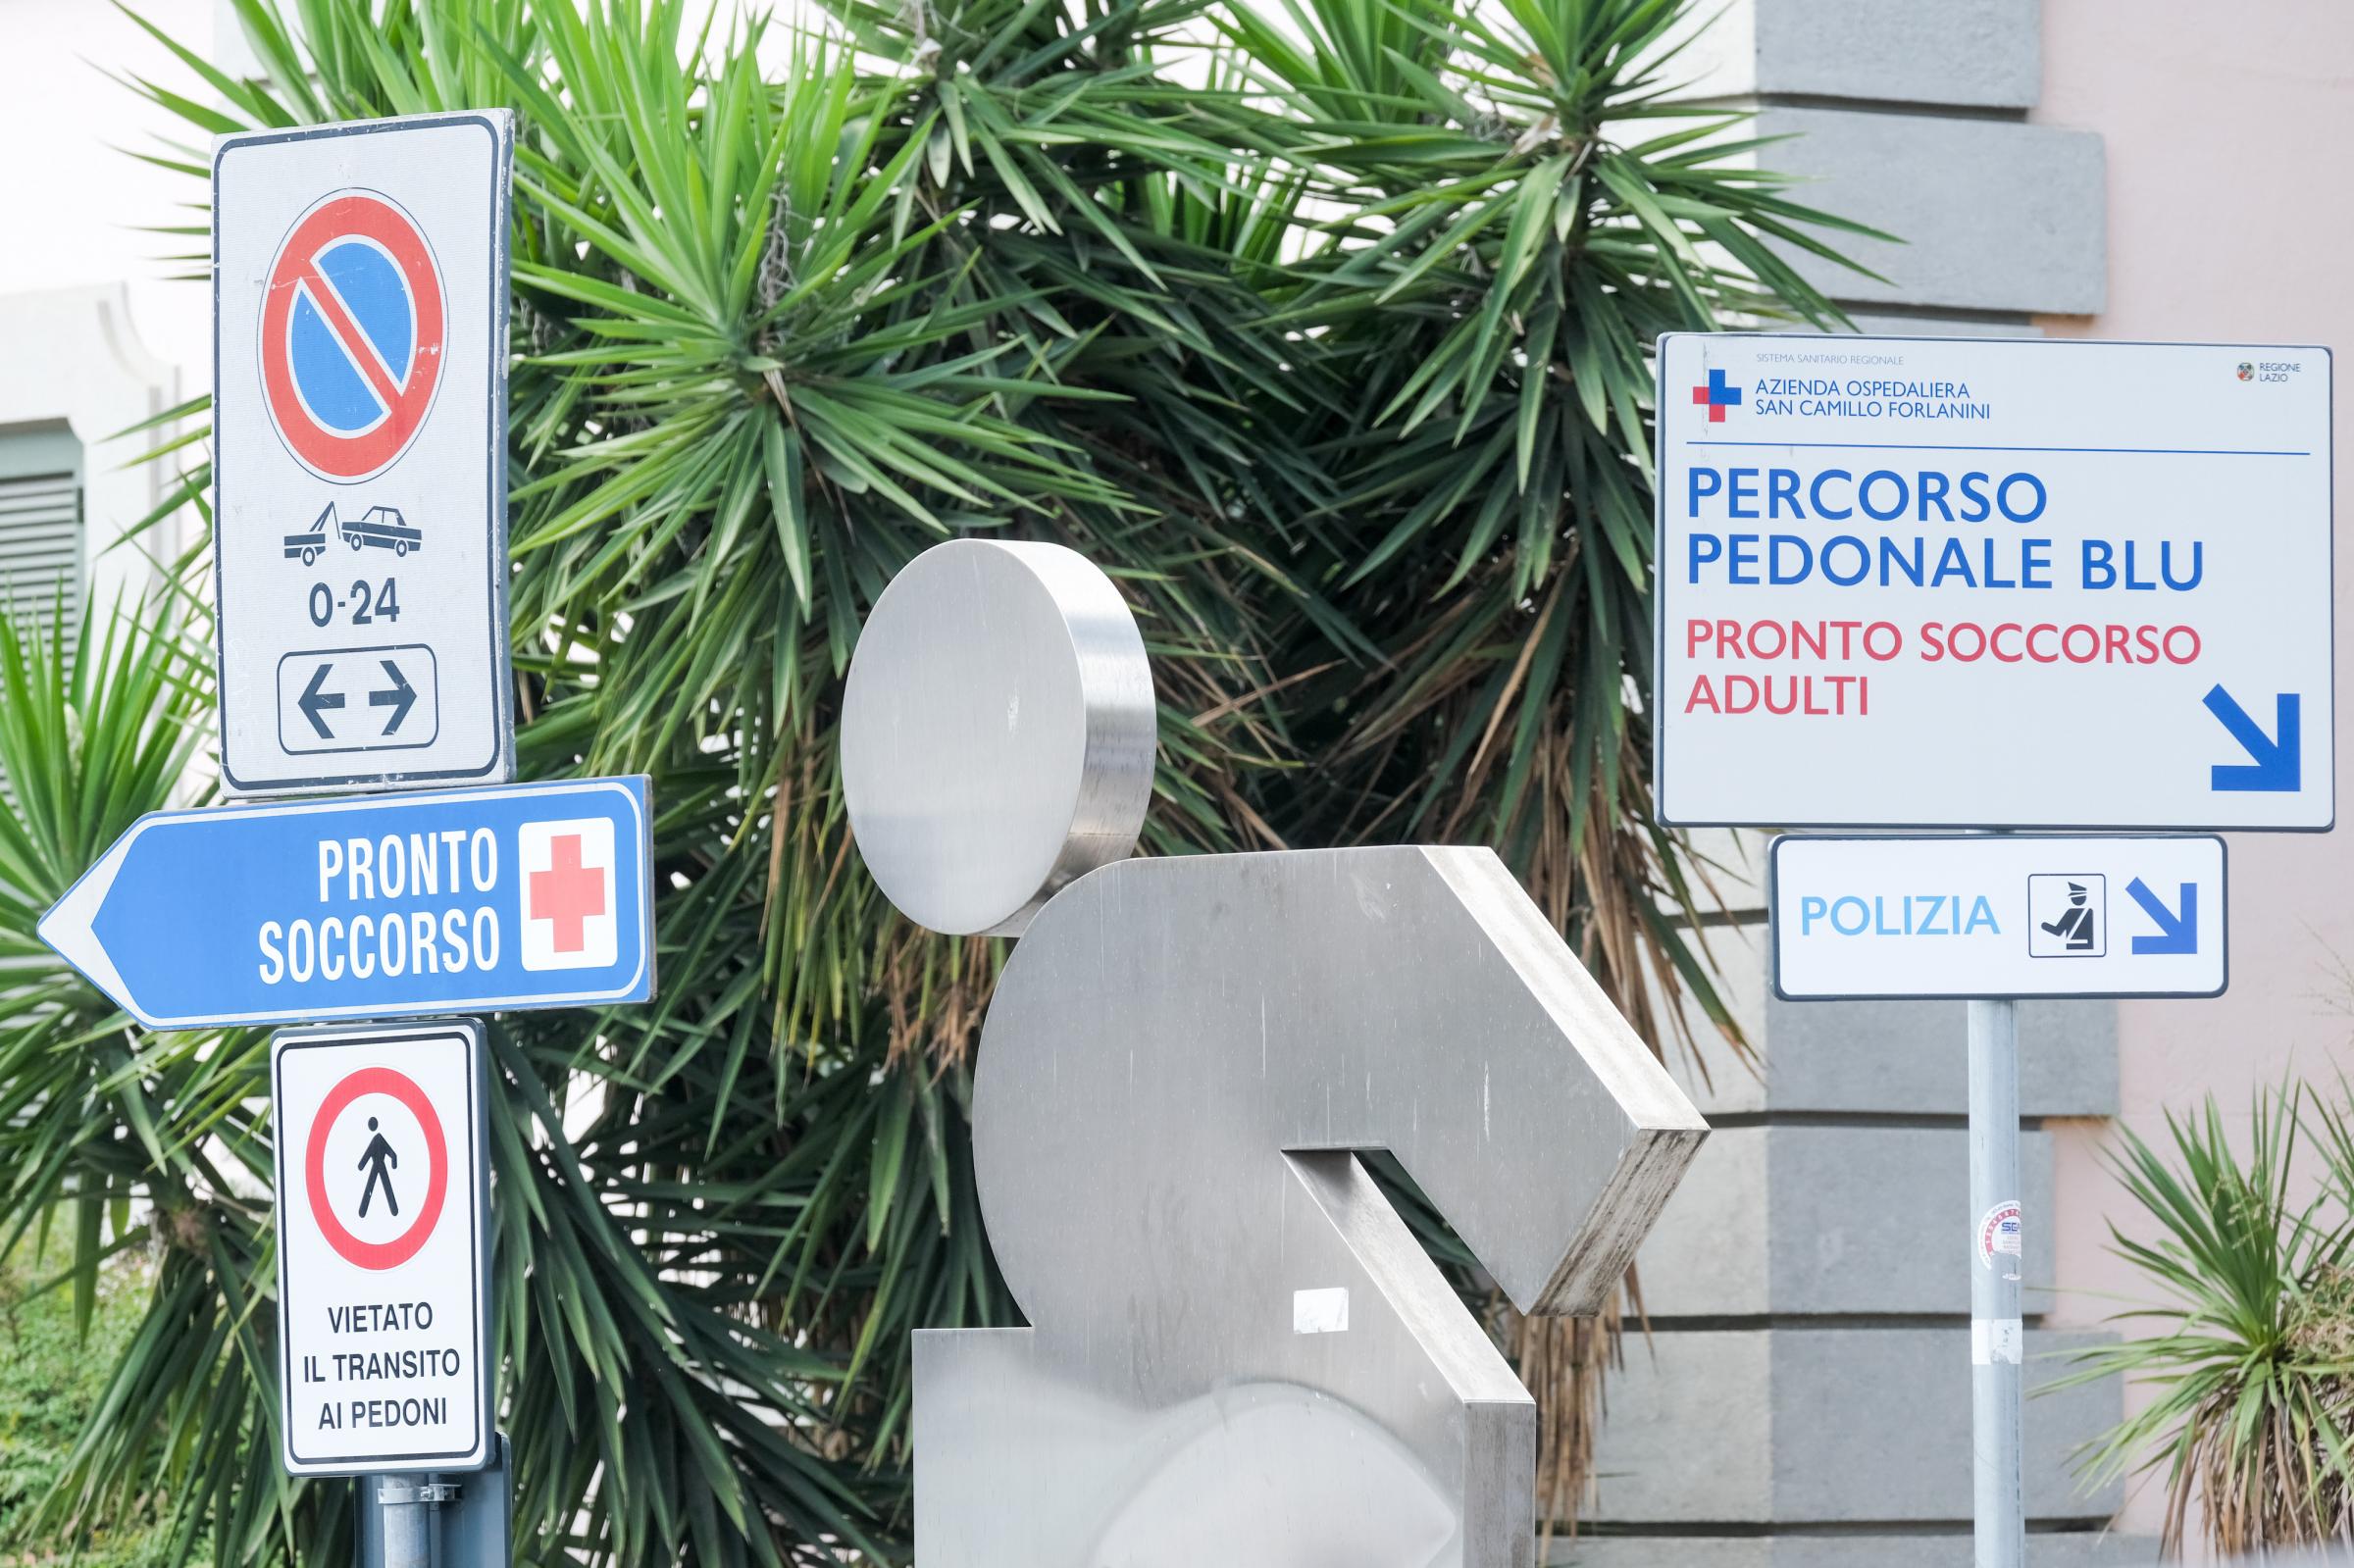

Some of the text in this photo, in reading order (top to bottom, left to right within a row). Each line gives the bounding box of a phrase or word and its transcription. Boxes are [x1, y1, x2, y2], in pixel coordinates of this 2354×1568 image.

[1756, 353, 1905, 366] SISTEMA SANITARIO REGIONALE
[2259, 362, 2301, 373] REGIONE
[2259, 373, 2289, 382] LAZIO
[1756, 379, 1970, 398] AZIENDA OSPEDALIERA
[1756, 398, 1990, 420] SAN CAMILLO FORLANINI
[1688, 468, 2047, 524] PERCORSO
[1688, 533, 2203, 592] PEDONALE BLU
[309, 577, 400, 627] 0-24
[1688, 620, 2202, 665] PRONTO SOCCORSO
[1684, 674, 1868, 716] ADULTI
[318, 827, 498, 902] PRONTO
[1802, 894, 2002, 936] POLIZIA
[258, 905, 500, 986] SOCCORSO
[328, 1301, 434, 1334] VIETATO
[304, 1347, 460, 1384] IL TRANSITO
[318, 1396, 447, 1431] AI PEDONI
